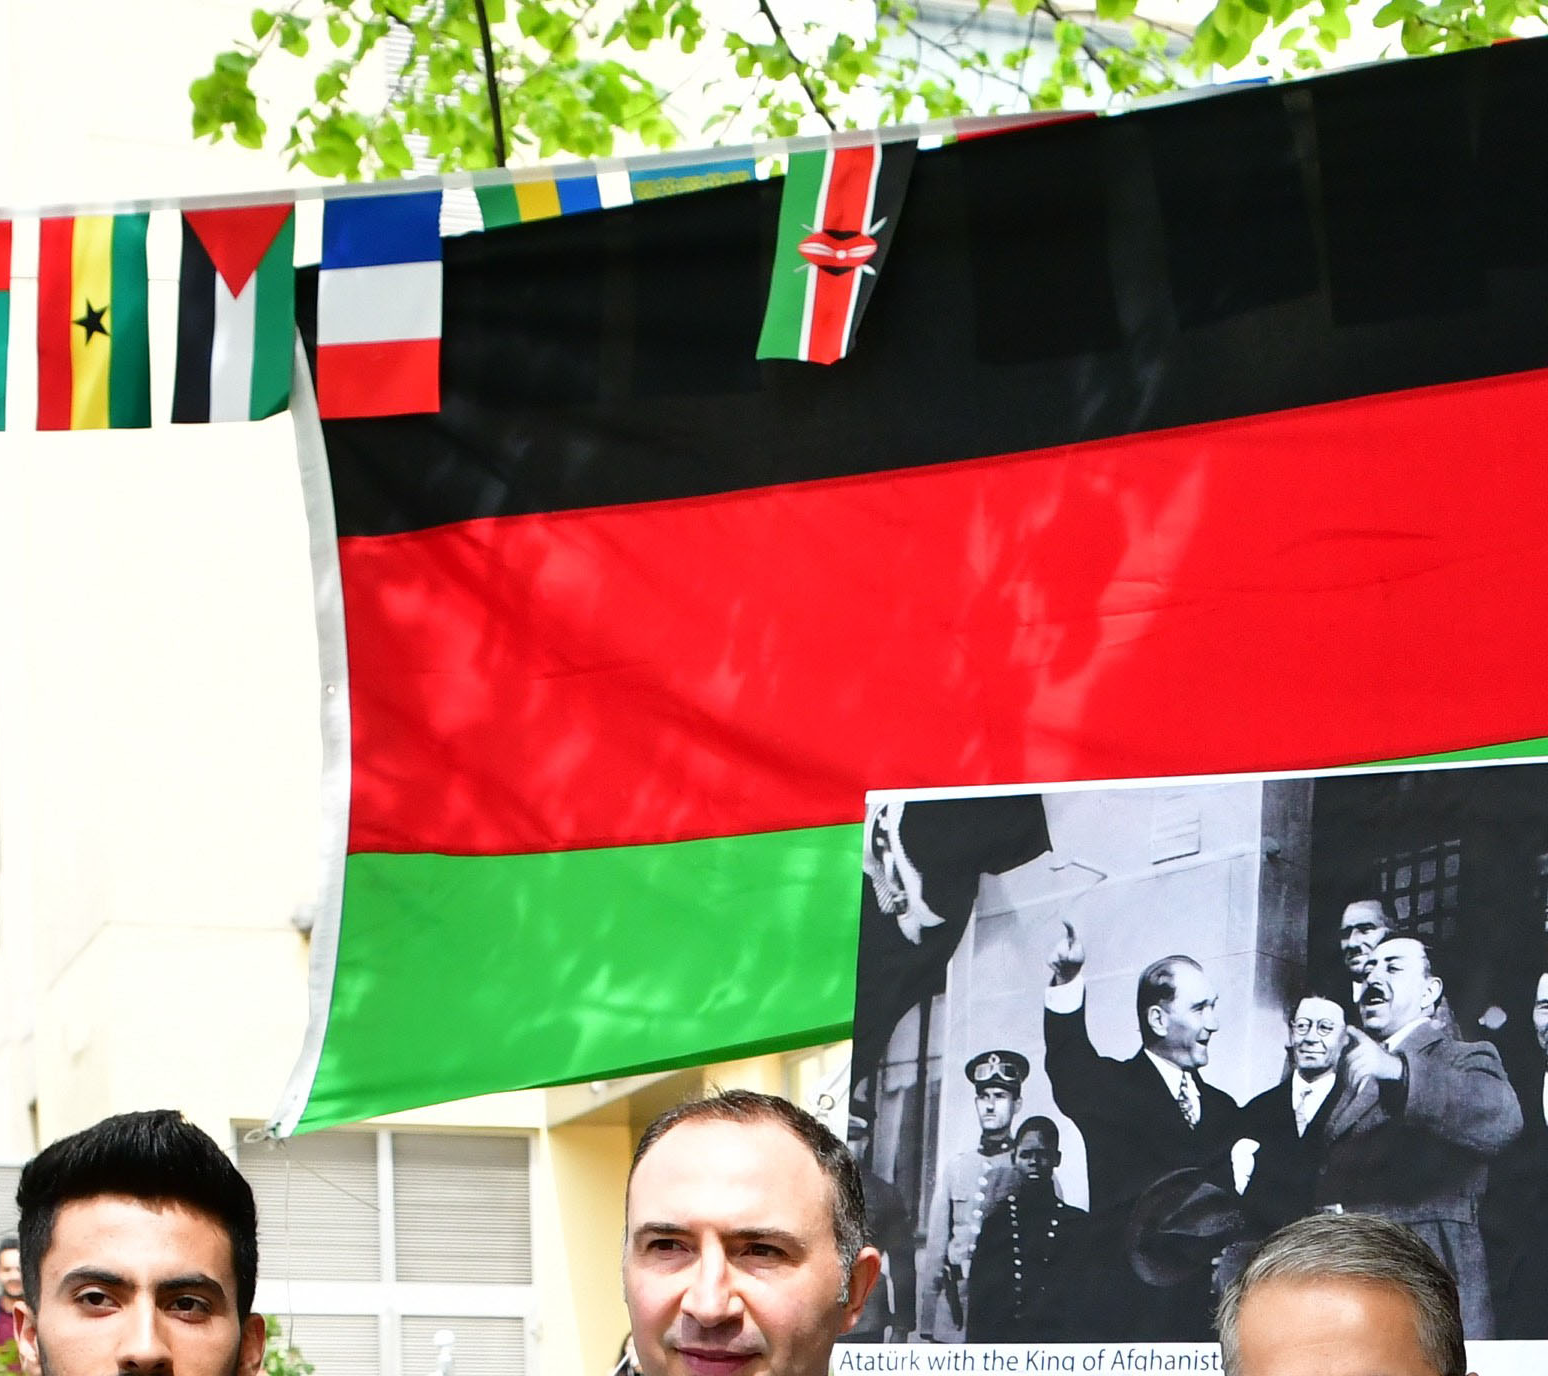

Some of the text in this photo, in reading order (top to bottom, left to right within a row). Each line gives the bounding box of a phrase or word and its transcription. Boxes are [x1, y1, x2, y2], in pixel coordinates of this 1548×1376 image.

[840, 1350, 919, 1371] Atatürk
[928, 1350, 974, 1371] with
[983, 1350, 1018, 1371] the
[1083, 1349, 1105, 1371] of
